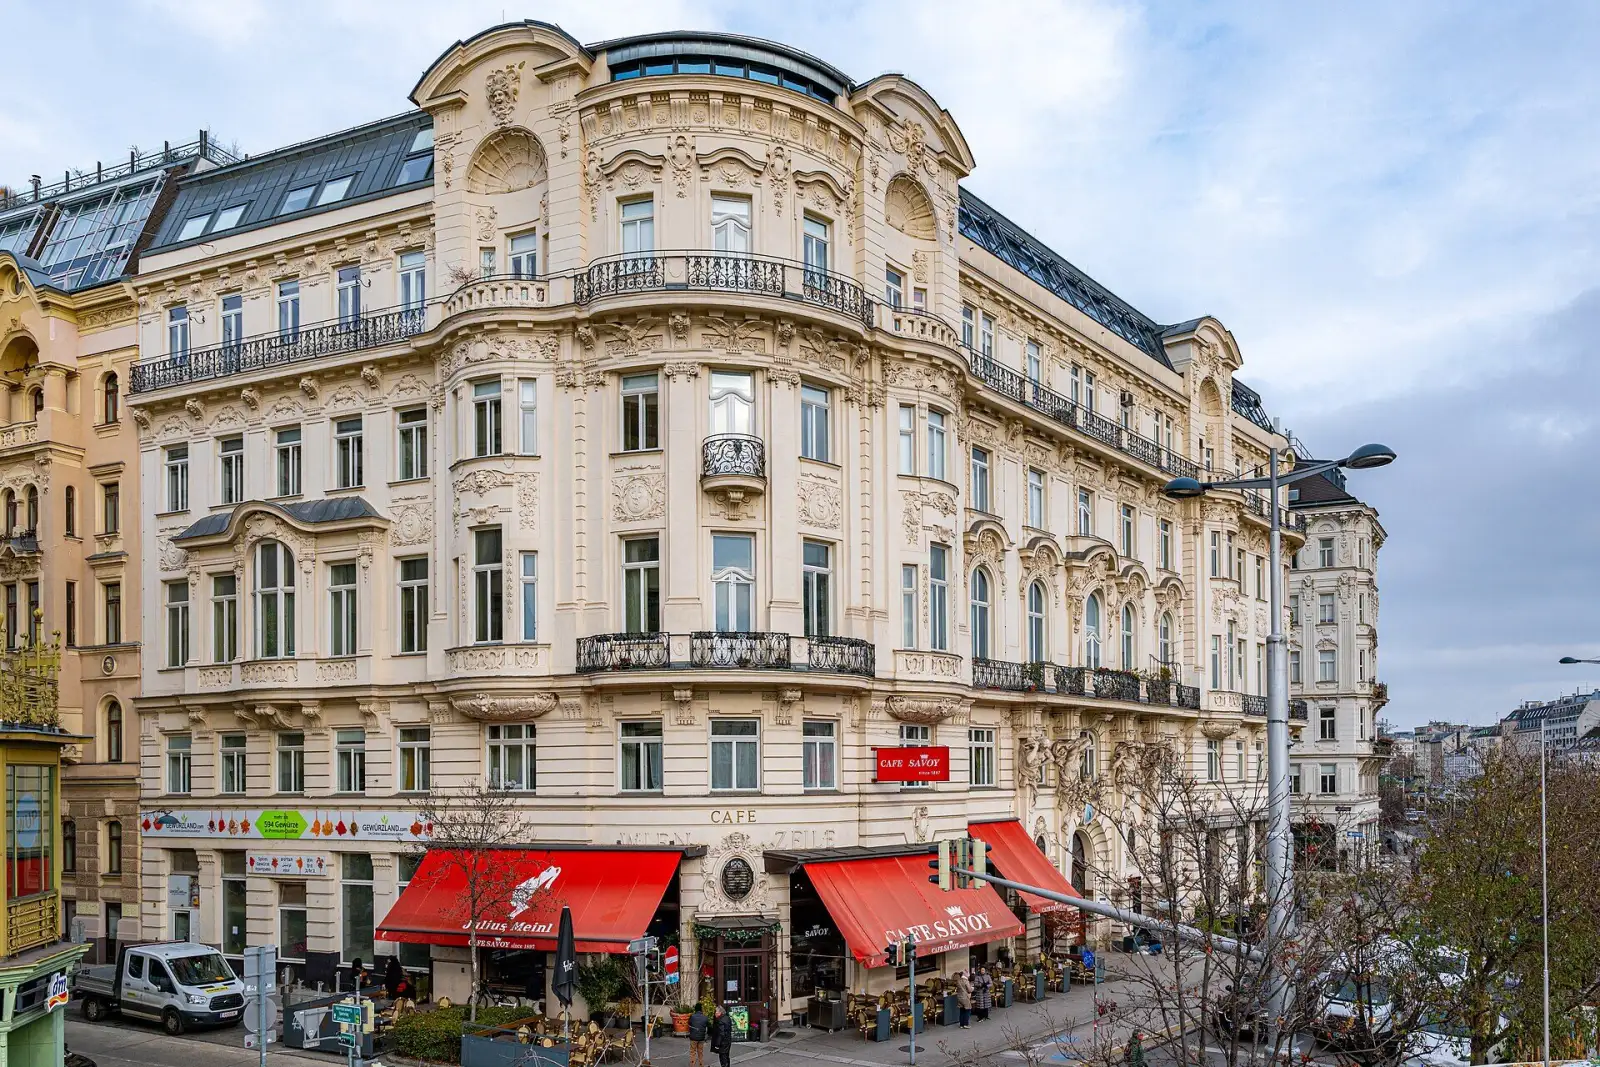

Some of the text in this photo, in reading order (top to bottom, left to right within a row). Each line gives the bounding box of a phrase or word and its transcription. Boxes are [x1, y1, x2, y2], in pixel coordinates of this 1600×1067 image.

[880, 758, 940, 768] CAFE SAVOY
[710, 810, 757, 823] CAFE
[275, 821, 299, 829] Gewürze
[362, 823, 408, 832] GEWÜRZLAND.com
[510, 921, 554, 933] Meinl
[805, 927, 829, 938] SAVOY
[885, 912, 992, 947] CAFE SAVOY
[468, 939, 486, 947] CFE
[486, 940, 511, 948] SAVOY
[52, 974, 67, 996] dm
